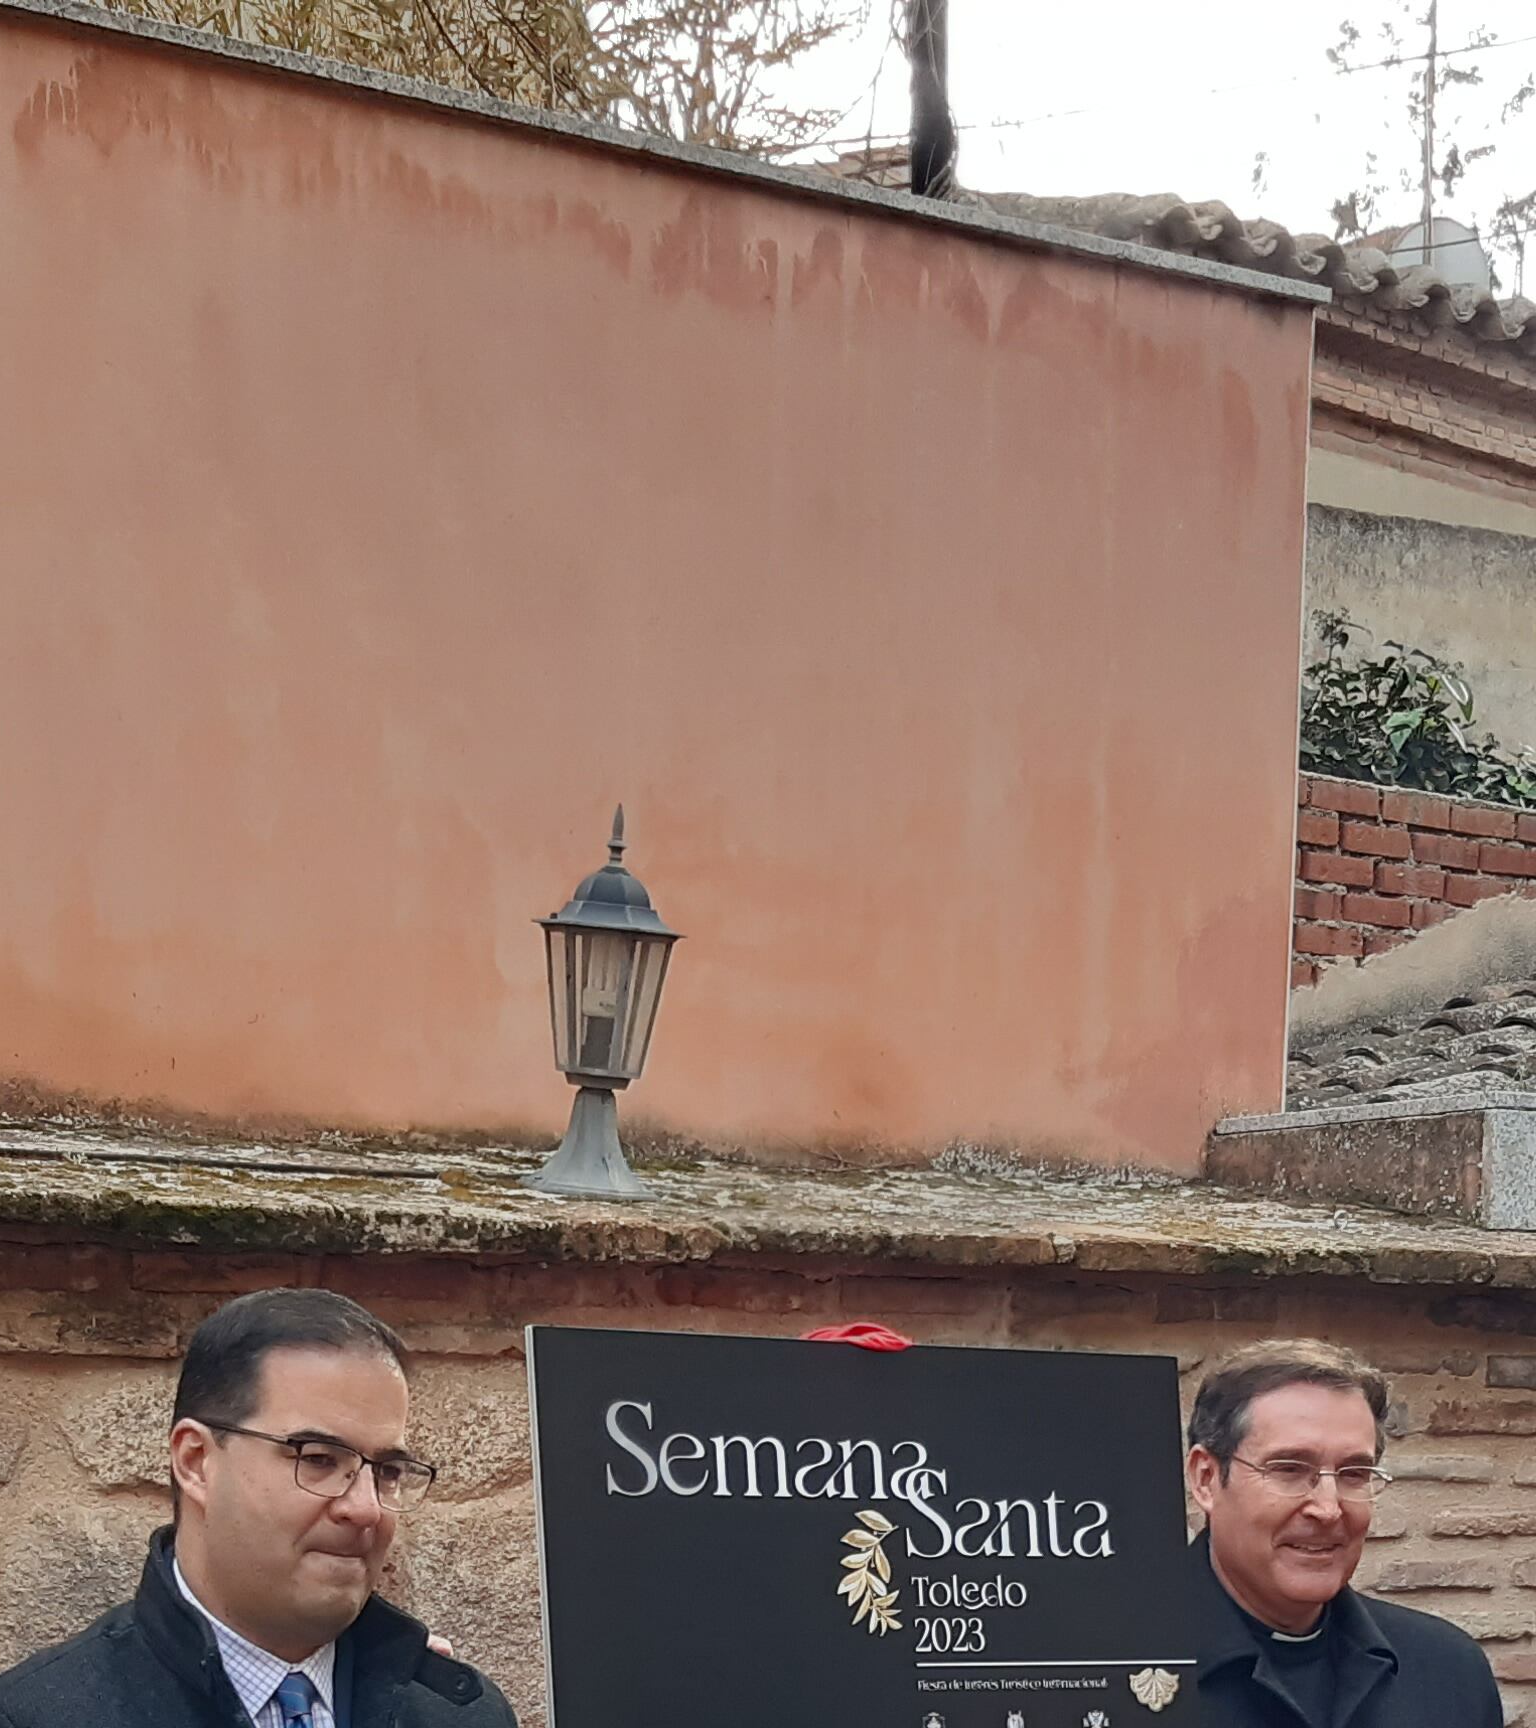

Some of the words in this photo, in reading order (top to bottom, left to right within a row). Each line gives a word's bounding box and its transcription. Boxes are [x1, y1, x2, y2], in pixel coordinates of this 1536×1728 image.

[605, 1399, 934, 1501] Semana
[904, 1467, 1115, 1559] Santa
[911, 1573, 1028, 1609] Toledo
[914, 1616, 986, 1653] 2023
[948, 1679, 962, 1690] de
